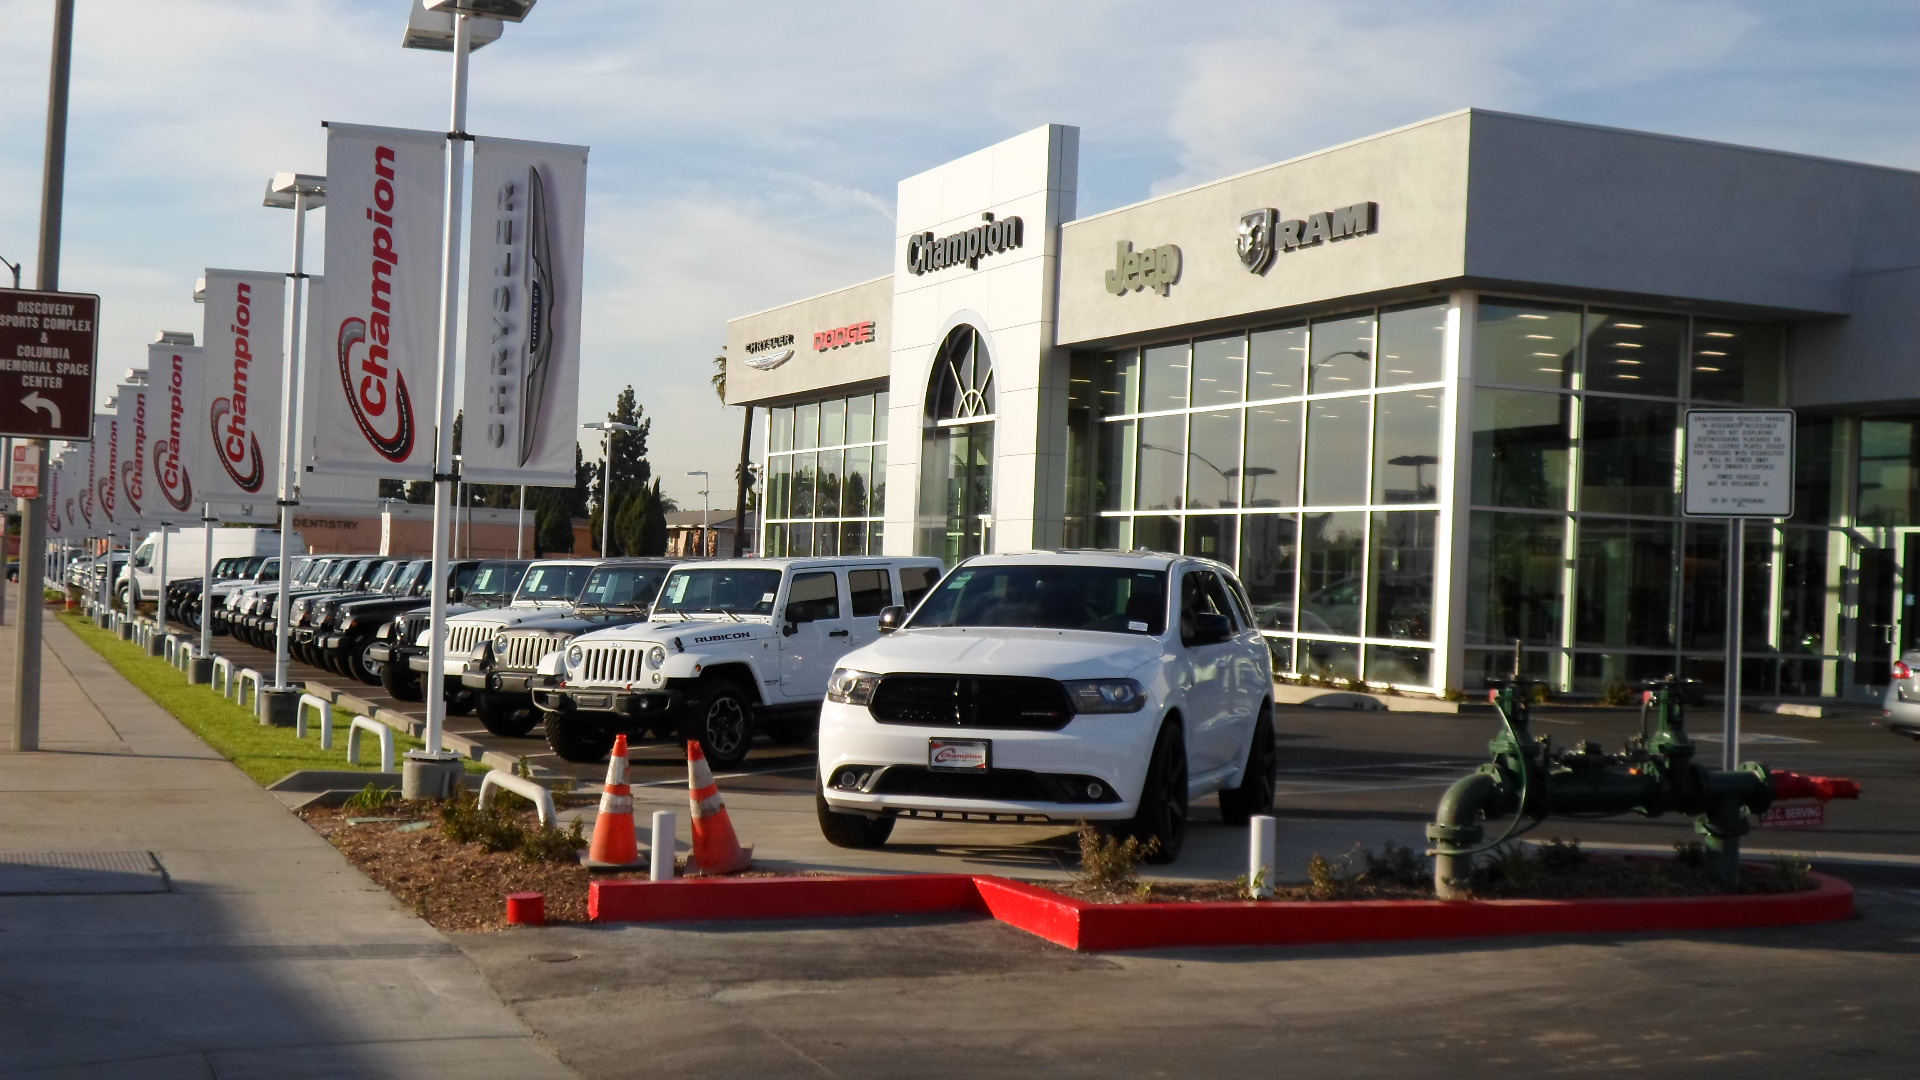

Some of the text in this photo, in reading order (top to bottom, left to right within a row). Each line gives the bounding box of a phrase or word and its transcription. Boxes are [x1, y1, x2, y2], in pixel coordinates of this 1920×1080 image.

[1274, 201, 1380, 253] RAM
[907, 212, 1024, 277] Champion
[360, 145, 398, 417] Champion
[1105, 240, 1183, 297] Jeep
[0, 314, 92, 332] SPORTS COMPLEX
[17, 301, 75, 316] DISCOVERY
[488, 184, 515, 449] CHRYSLER
[532, 289, 541, 348] CHRYSLER
[17, 345, 70, 360] COLUMBIA
[40, 331, 49, 344] &
[745, 334, 795, 354] CHRYSLER
[813, 320, 876, 353] DODGE
[22, 375, 63, 389] CENTER
[56, 362, 89, 376] SPACE
[225, 282, 252, 463] Champion
[164, 354, 184, 489] Champion
[130, 392, 147, 500] Champion
[106, 421, 117, 510] Champion
[292, 518, 358, 530] DENTISTRY
[694, 632, 750, 643] RUBICON
[1785, 806, 1822, 819] SERVING
